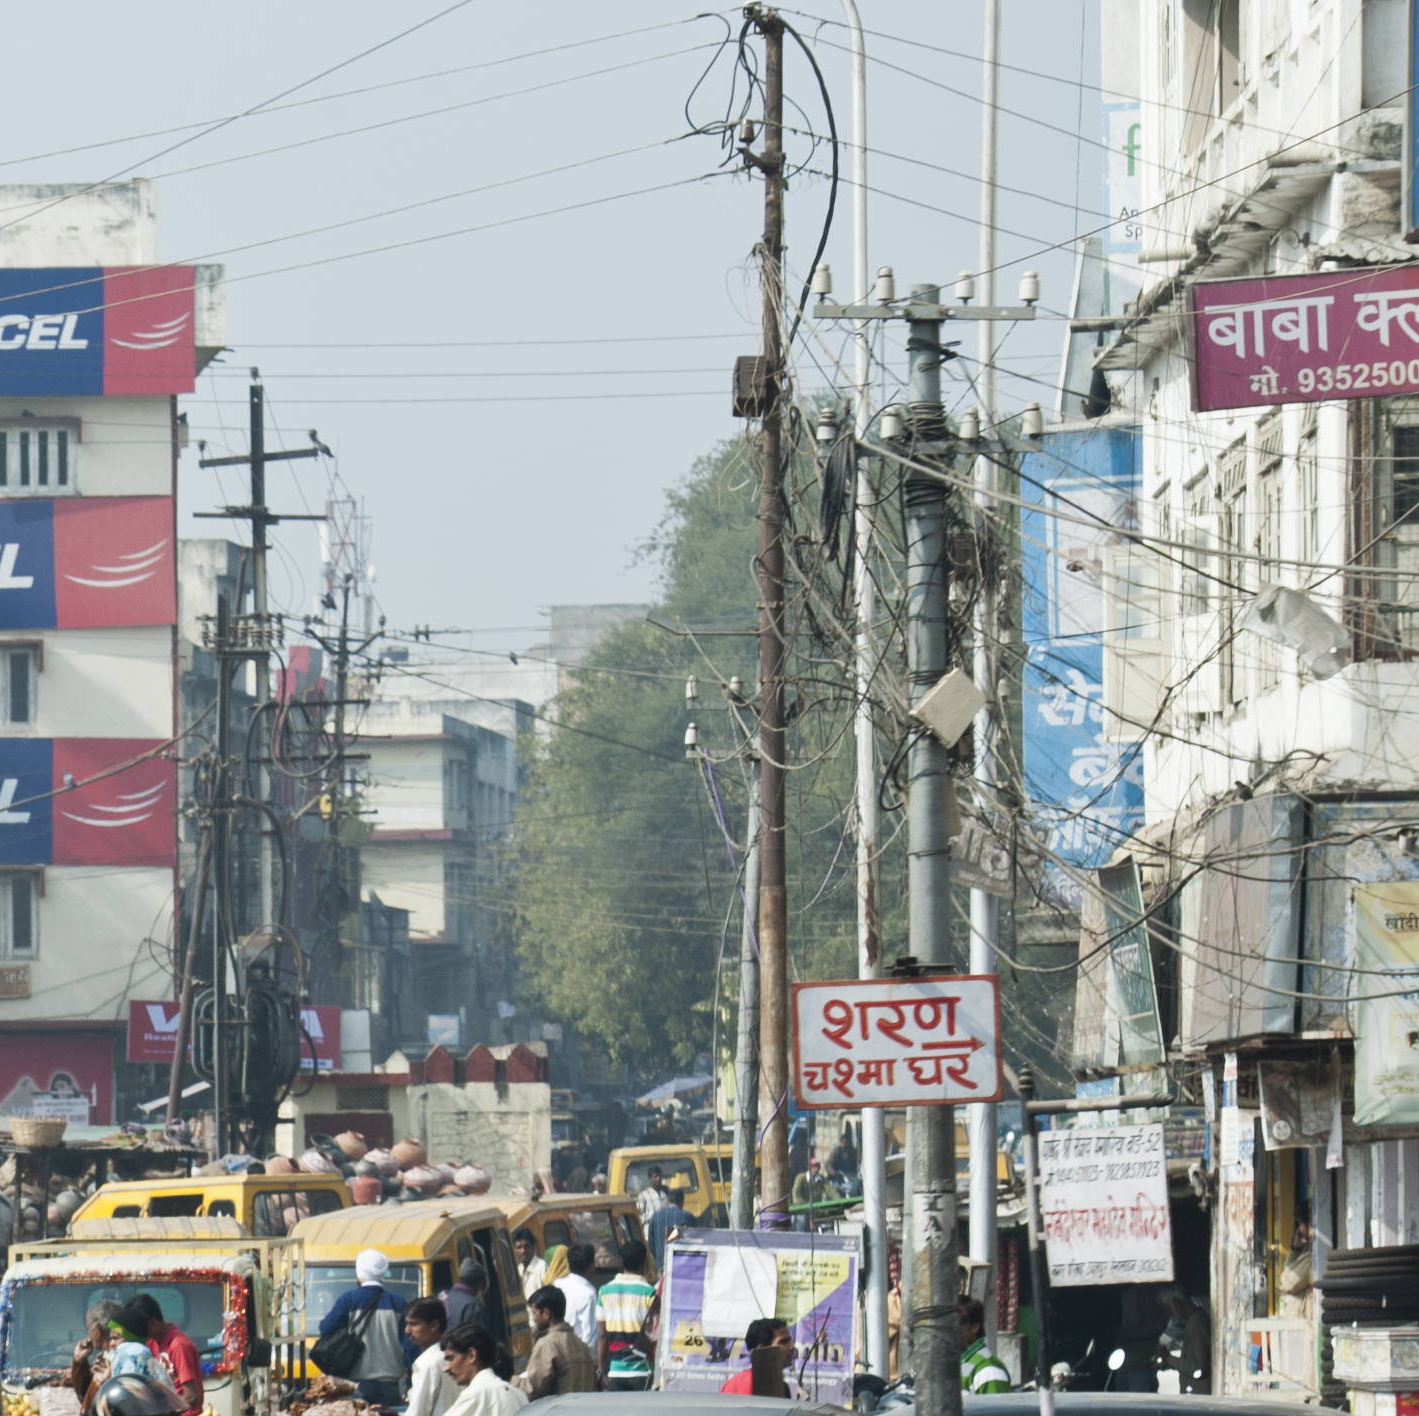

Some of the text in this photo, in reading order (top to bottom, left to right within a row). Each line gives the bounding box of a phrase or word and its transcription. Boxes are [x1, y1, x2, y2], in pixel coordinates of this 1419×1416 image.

[1204, 295, 1335, 360] बाबा
[821, 996, 962, 1050] शरण
[803, 1053, 978, 1099] चश्मा घर
[684, 1334, 704, 1347] 26
